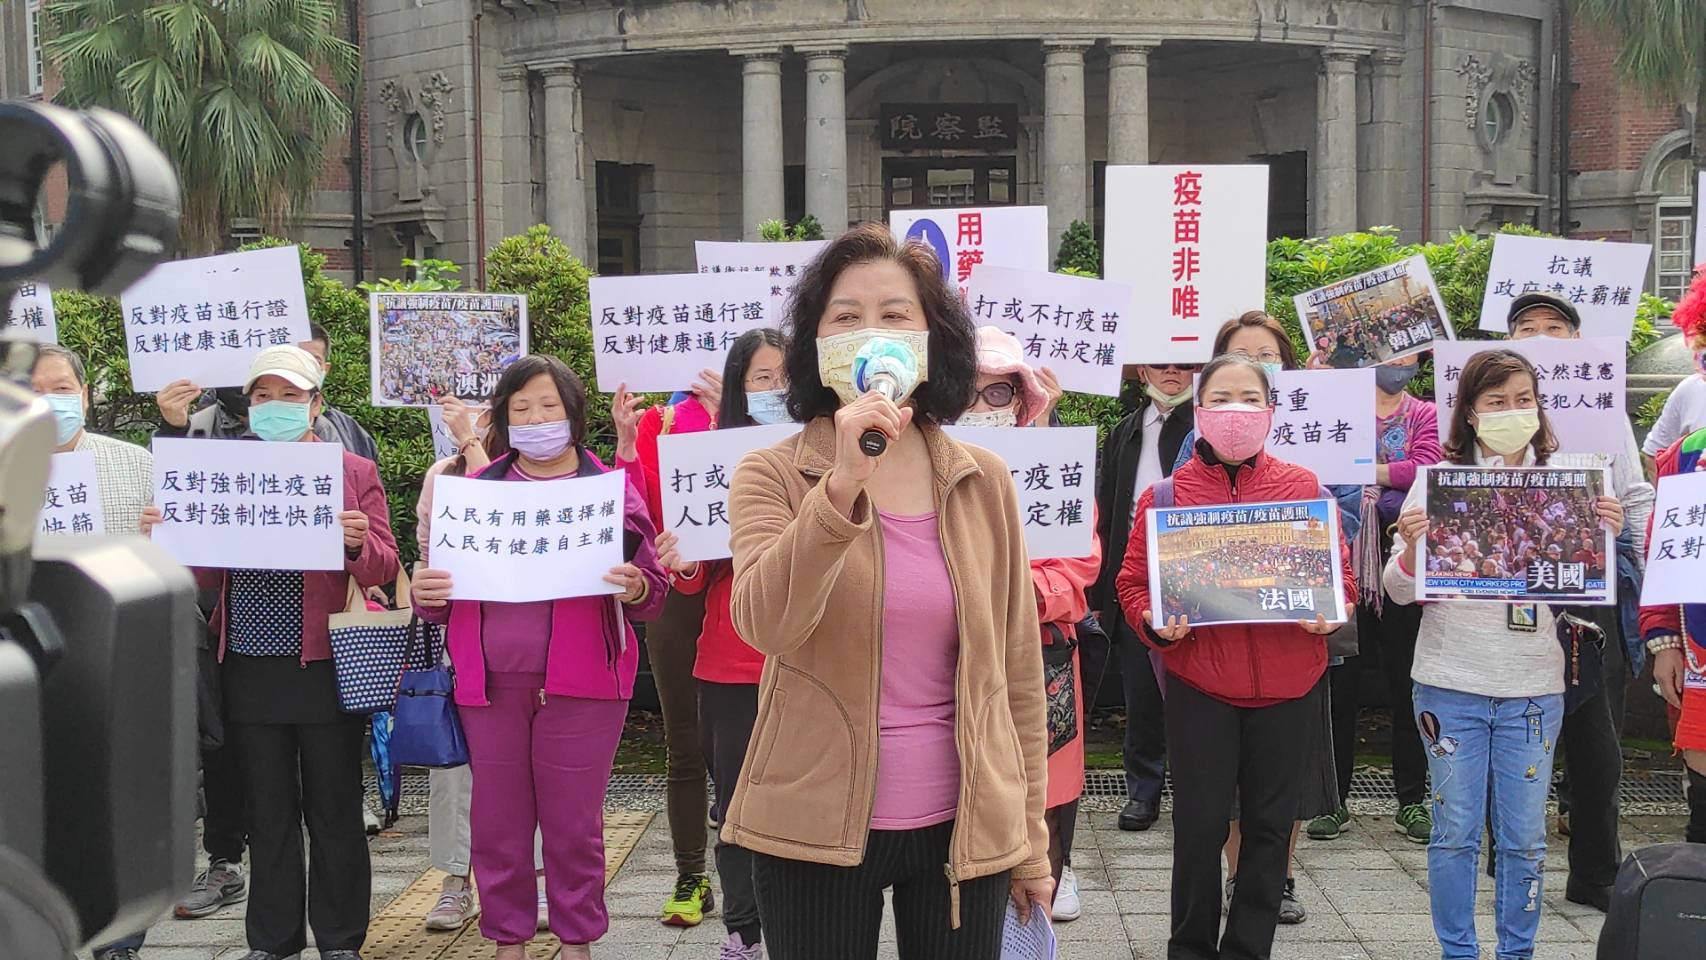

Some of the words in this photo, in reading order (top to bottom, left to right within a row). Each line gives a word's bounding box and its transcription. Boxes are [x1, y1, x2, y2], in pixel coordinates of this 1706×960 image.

[957, 213, 984, 297] 用藥
[1171, 171, 1202, 341] 疫苗非唯一
[1547, 255, 1592, 277] 抗議
[131, 299, 288, 325] 反對疫苗通行證
[600, 301, 764, 326] 反對疫苗通行證
[974, 294, 1119, 334] 打或不打疫苗
[134, 326, 291, 352] 反對健康通行證
[602, 331, 739, 355] 反對健康通行
[1006, 332, 1116, 366] 有決定權
[1389, 322, 1432, 349] 韓國
[455, 373, 501, 396] 澳洲
[1534, 362, 1614, 381] 公然違憲
[1273, 419, 1352, 446] 疫苗者
[161, 470, 333, 496] 反對強制性疫苗
[671, 464, 729, 493] 打或
[1010, 462, 1083, 491] 疫苗
[1438, 472, 1587, 487] 抗議強制疫苗/疫苗護照
[162, 502, 334, 529] 反對強制性快篩
[438, 500, 615, 527] 人民有用藥選擇權
[675, 501, 729, 528] 人民
[1024, 498, 1083, 527] 定權
[1167, 506, 1308, 527] 抗議強制疫苗/疫苗護照
[1660, 504, 1706, 528] 反對
[436, 526, 614, 555] 人民有健康自主權
[1655, 536, 1705, 560] 反對
[1528, 562, 1585, 590] 美國
[1259, 588, 1315, 611] 法國
